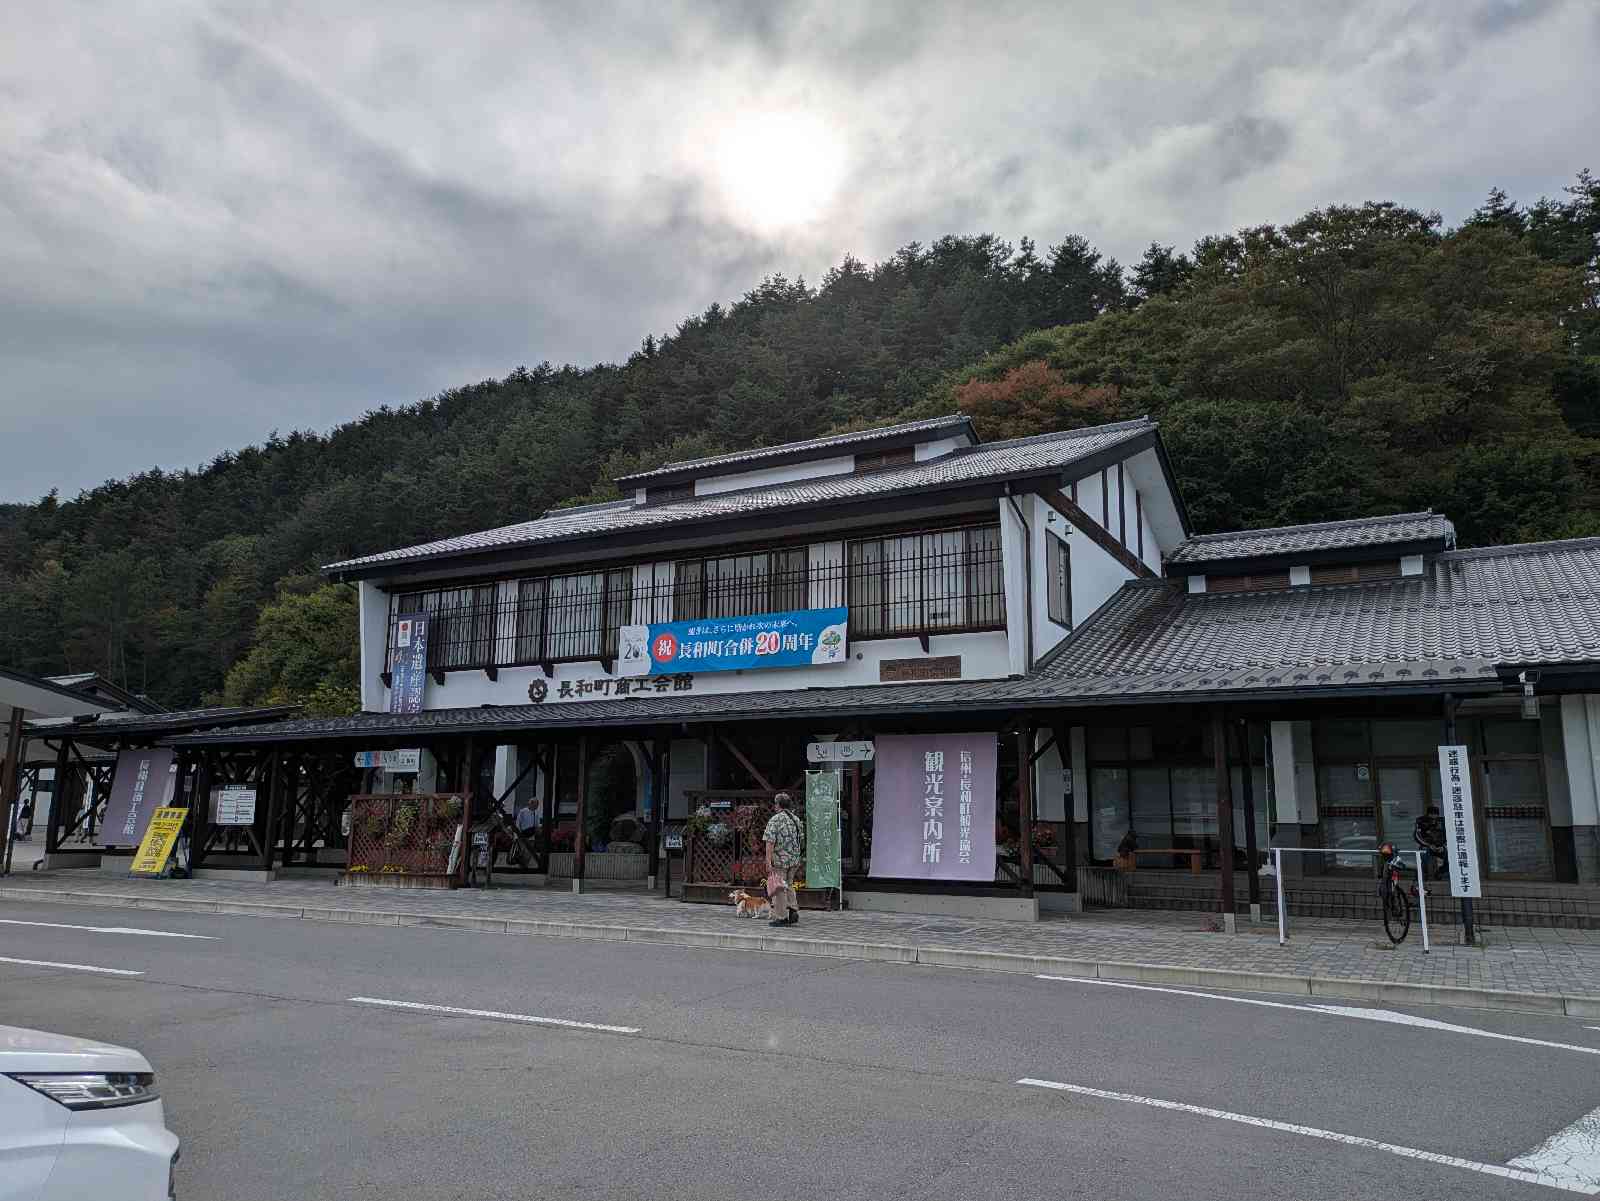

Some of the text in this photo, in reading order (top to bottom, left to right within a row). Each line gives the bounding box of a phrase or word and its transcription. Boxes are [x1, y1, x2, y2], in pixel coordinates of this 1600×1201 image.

[657, 640, 673, 656] 祝
[679, 631, 814, 660] 長和町合併20周年
[557, 671, 694, 698] 長和町商工会館
[922, 751, 944, 864] 観光案内所
